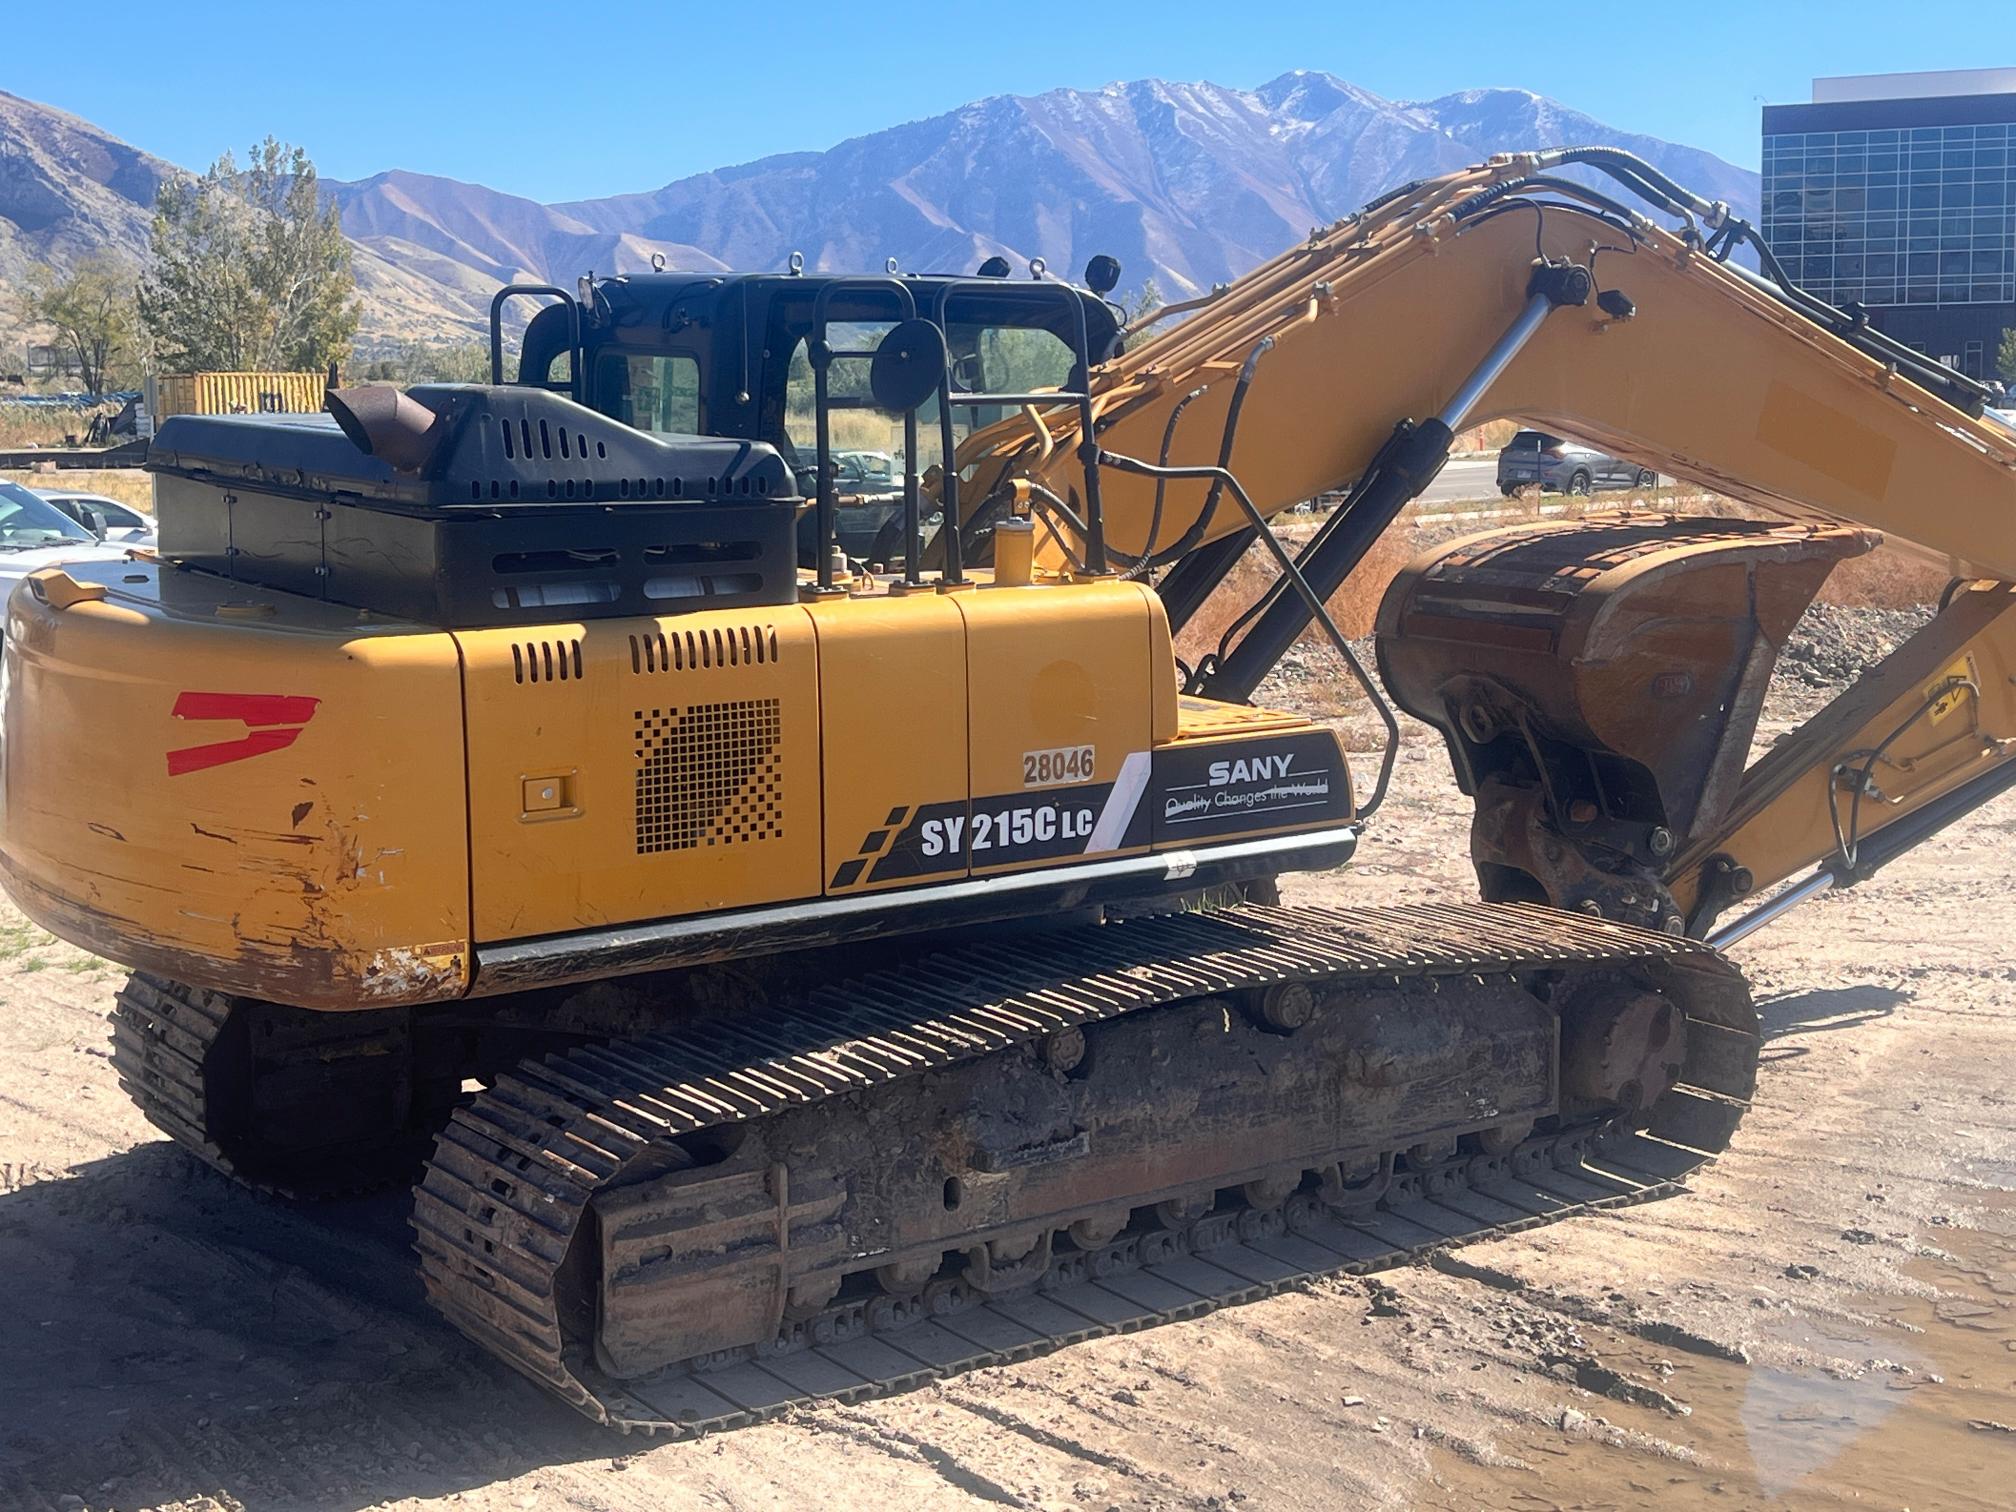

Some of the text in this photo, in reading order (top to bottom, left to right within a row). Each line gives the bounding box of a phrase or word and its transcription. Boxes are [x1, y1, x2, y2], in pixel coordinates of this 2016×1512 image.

[1024, 749, 1094, 783] 28046
[1209, 754, 1294, 786] SANY
[1215, 790, 1266, 807] Changes
[1291, 778, 1328, 797] Wold
